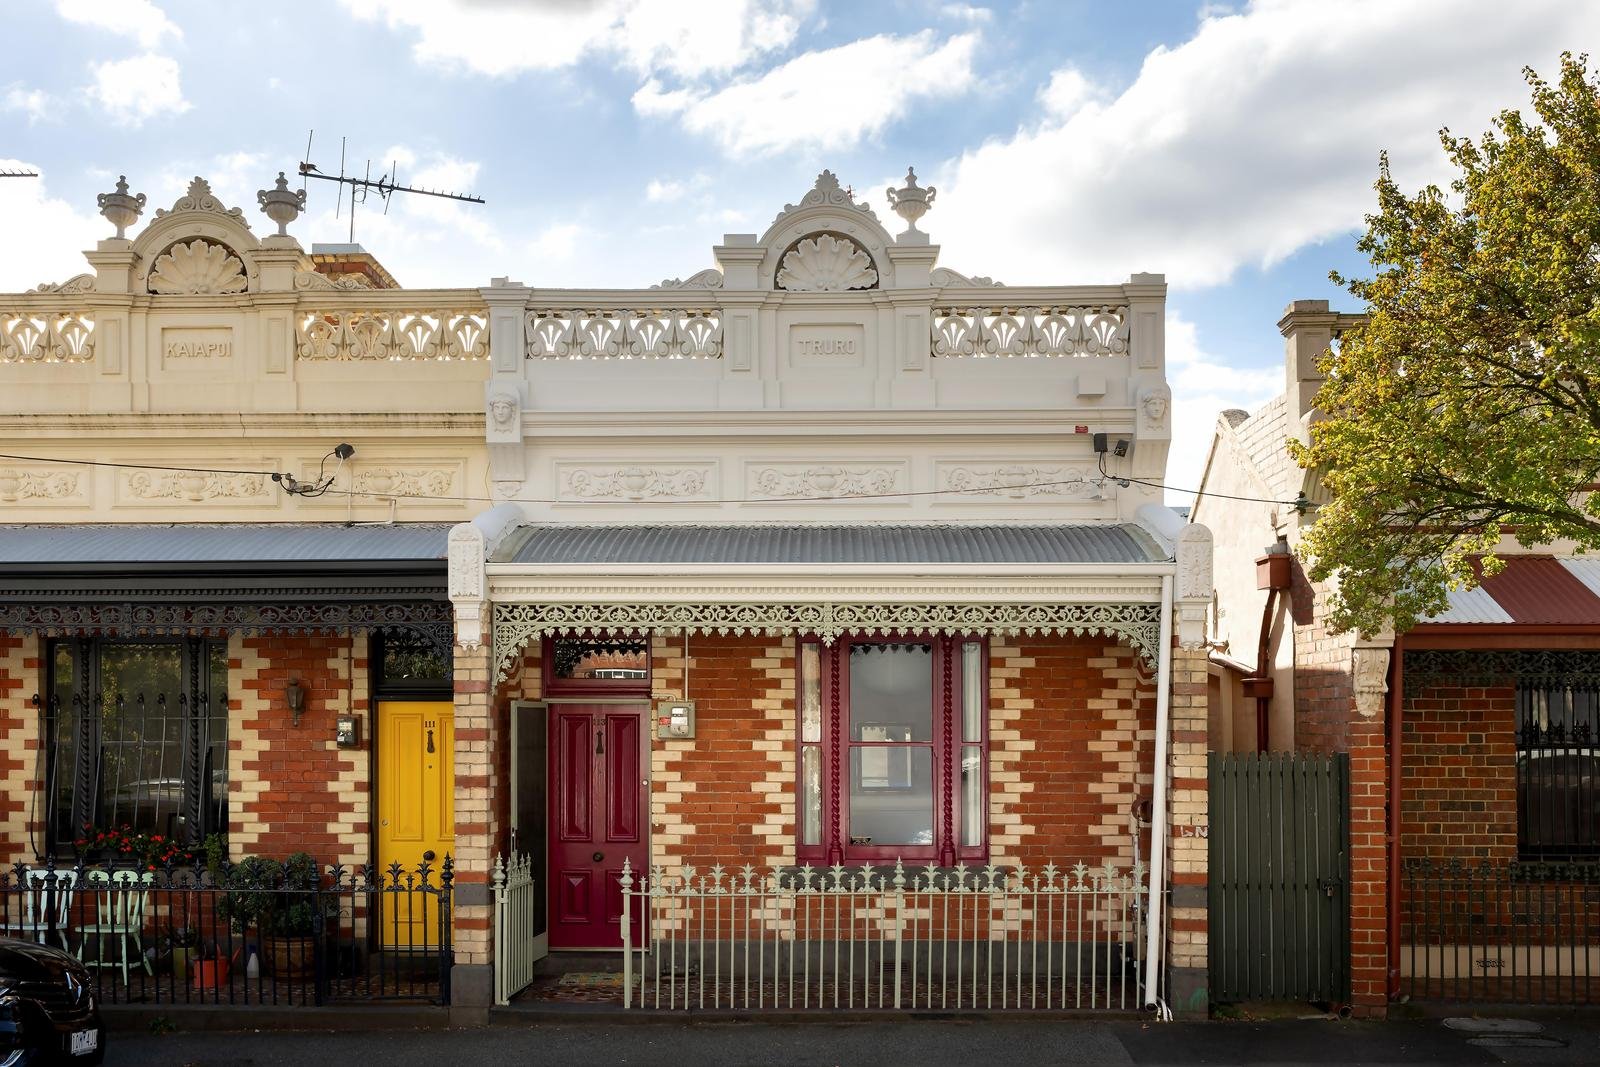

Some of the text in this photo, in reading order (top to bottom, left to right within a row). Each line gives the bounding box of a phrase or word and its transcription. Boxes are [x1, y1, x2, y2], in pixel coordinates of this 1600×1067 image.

[166, 342, 232, 358] KAIAPOI
[798, 340, 856, 355] TRURO
[424, 720, 436, 728] 111
[593, 718, 606, 726] 113
